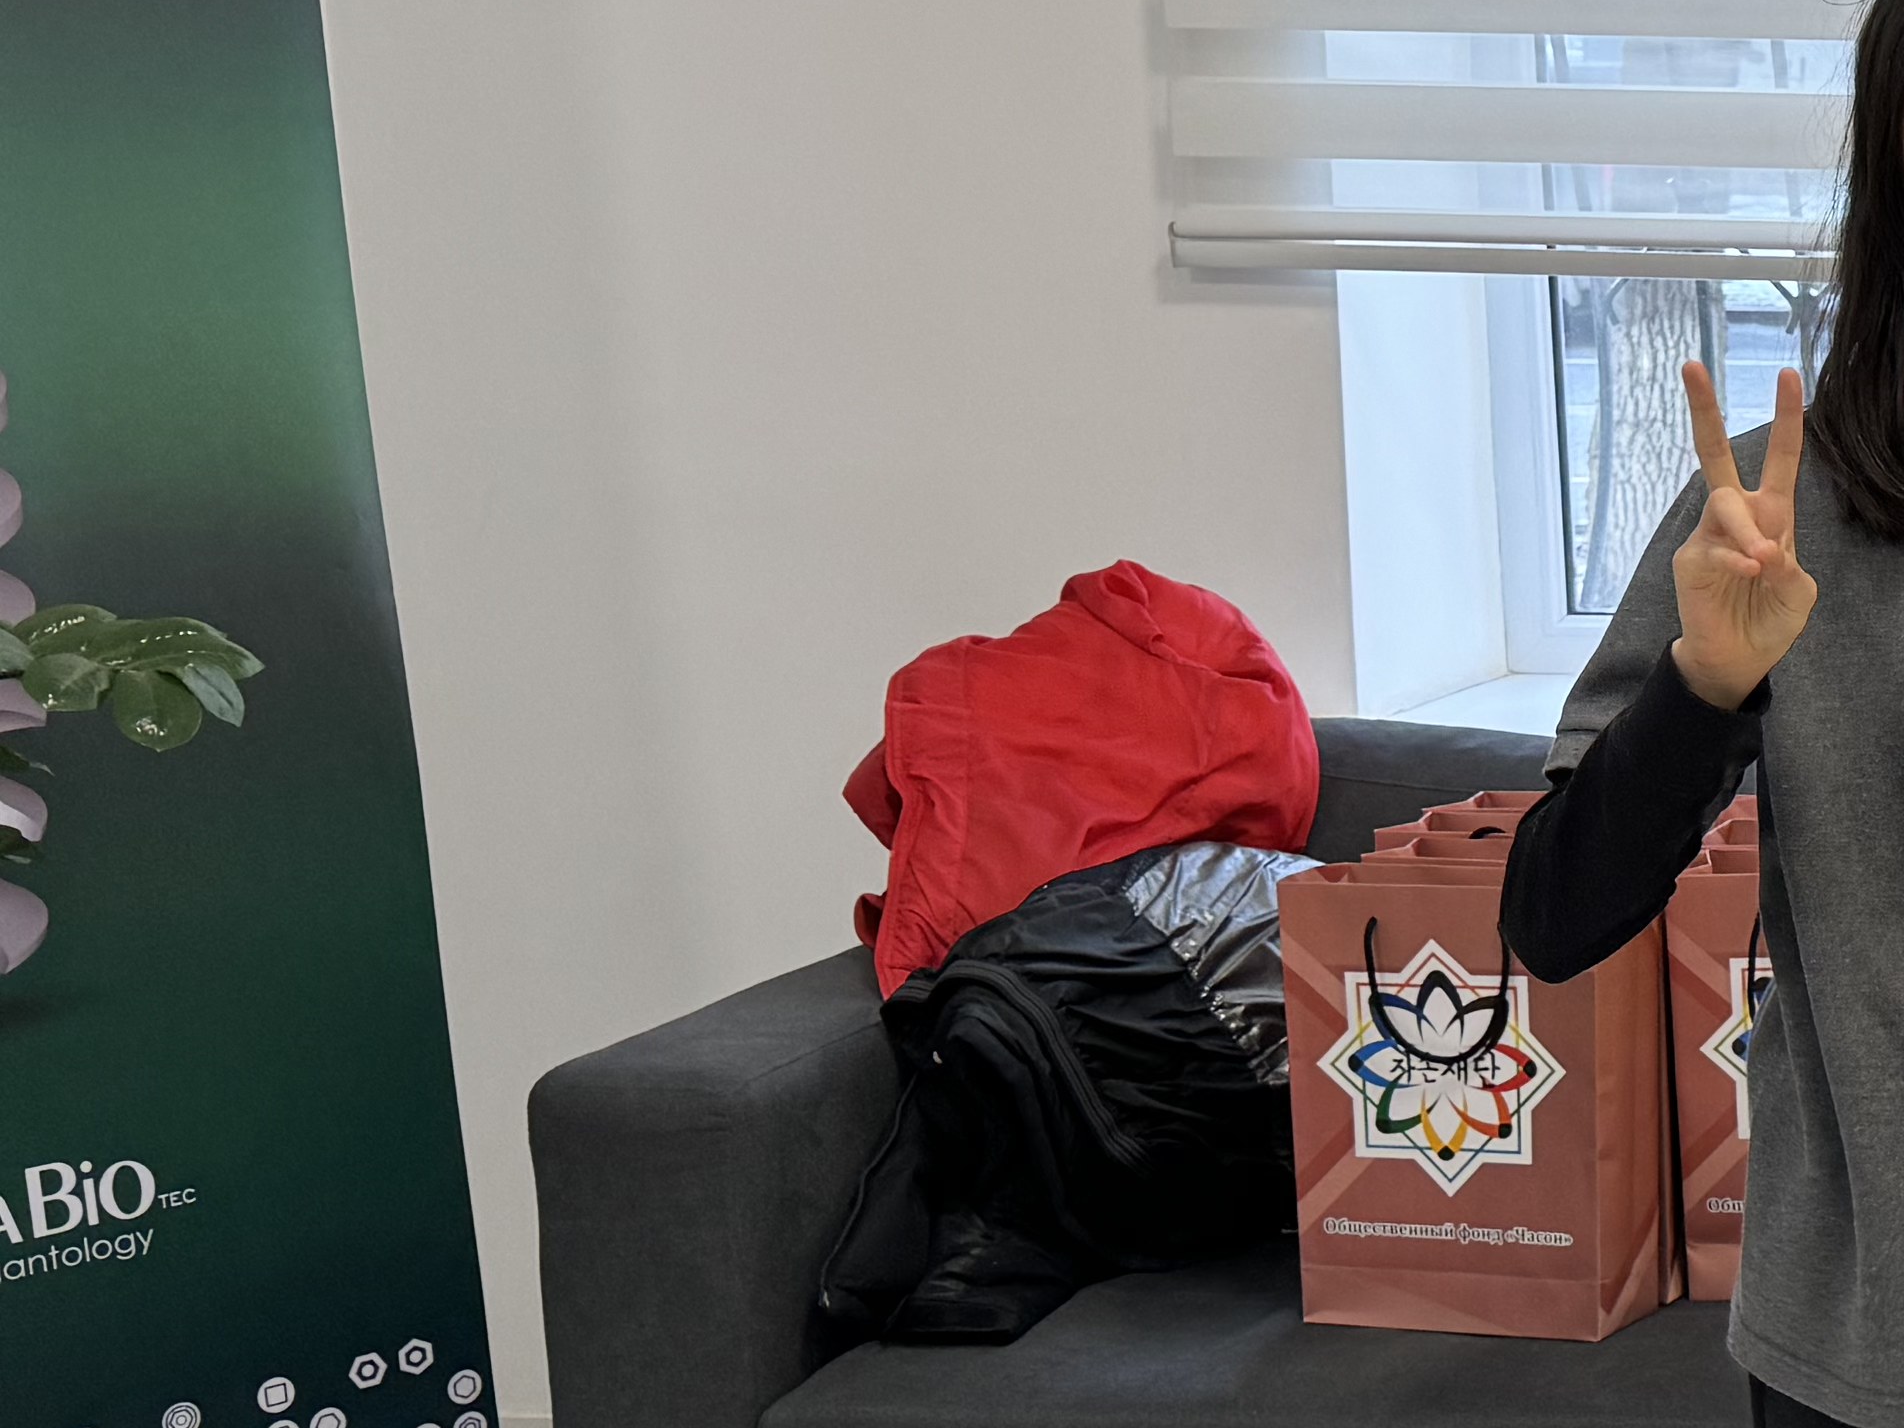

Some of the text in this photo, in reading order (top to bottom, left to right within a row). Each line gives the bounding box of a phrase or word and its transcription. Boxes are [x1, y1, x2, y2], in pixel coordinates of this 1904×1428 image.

[157, 1187, 197, 1209] TEC
[1324, 1217, 1456, 1240] Общественный
[1458, 1222, 1503, 1245] фонд
[0, 1228, 154, 1284] antology
